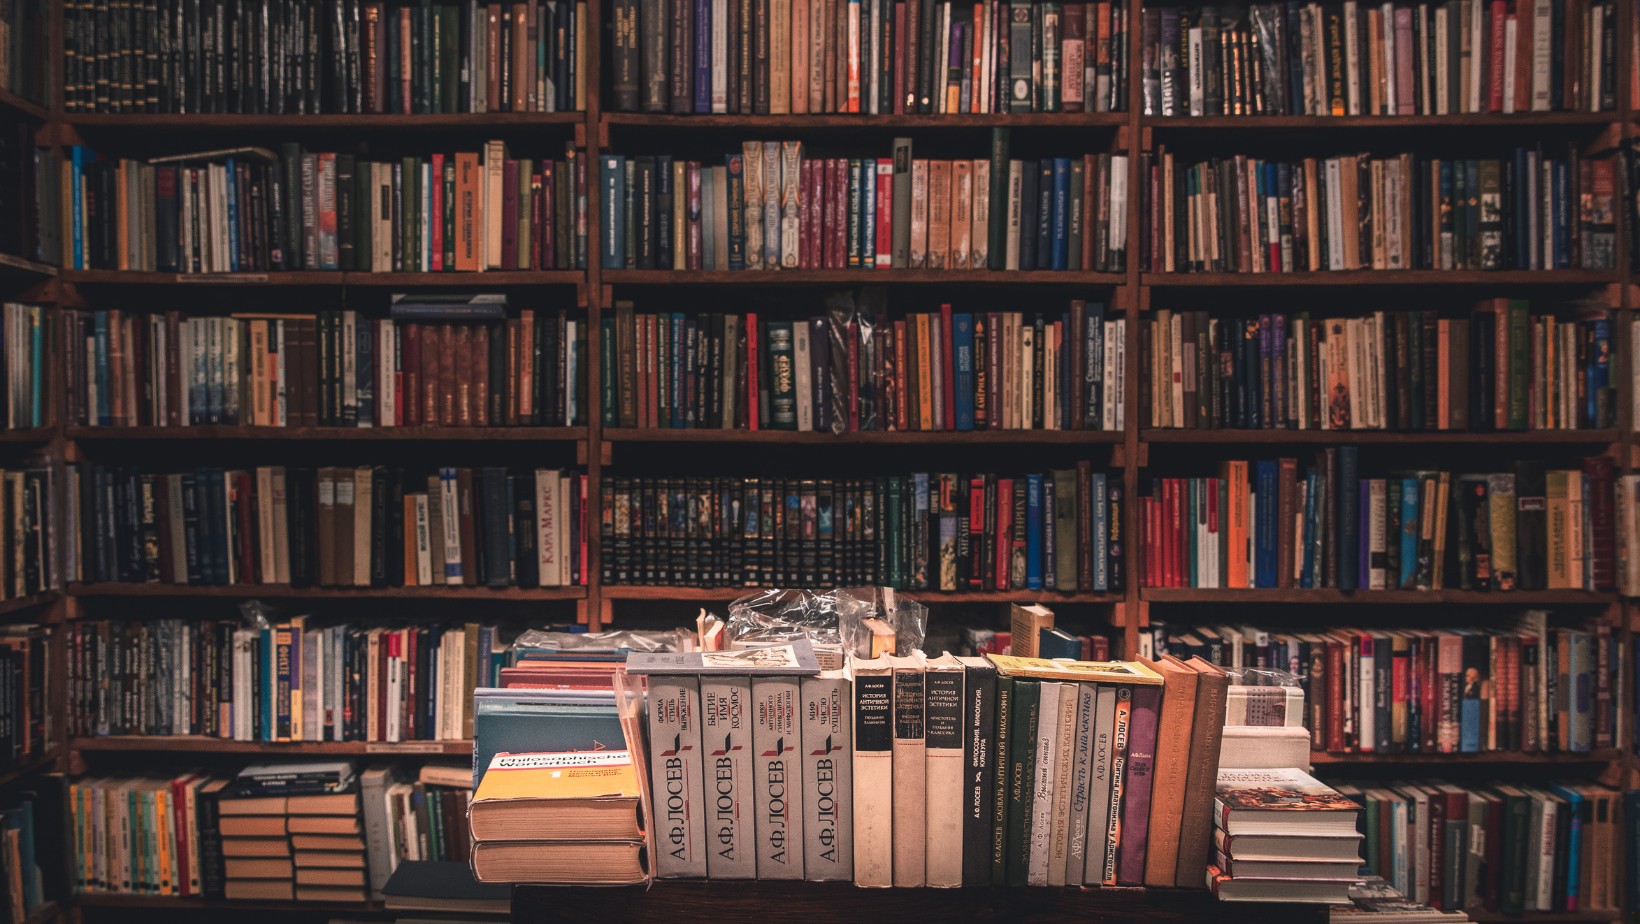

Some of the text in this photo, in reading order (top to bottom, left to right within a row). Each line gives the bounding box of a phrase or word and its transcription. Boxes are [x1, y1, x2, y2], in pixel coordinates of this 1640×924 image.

[541, 486, 554, 564] КАРЛ МАРКС
[707, 692, 716, 726] БЫТИЕ
[719, 697, 728, 721] ИМЯ
[730, 687, 740, 729] КОСМОС
[831, 688, 839, 734] СУЩНОСТЬ
[999, 690, 1008, 739] ФИЛОСОФИИ
[1116, 721, 1126, 749] ЛОСЕВ
[499, 759, 597, 767] Wörterbuch
[1054, 699, 1073, 860] ИСТОРИЯ ЭСТЕТИЧЕСКИХ КАТЕГОРИЙ
[1113, 757, 1122, 788] Критика
[996, 787, 1004, 822] СЛОВАРЬ
[1073, 767, 1087, 812] Страсть
[1109, 790, 1120, 832] платонизма
[1105, 839, 1116, 881] Аристотеля
